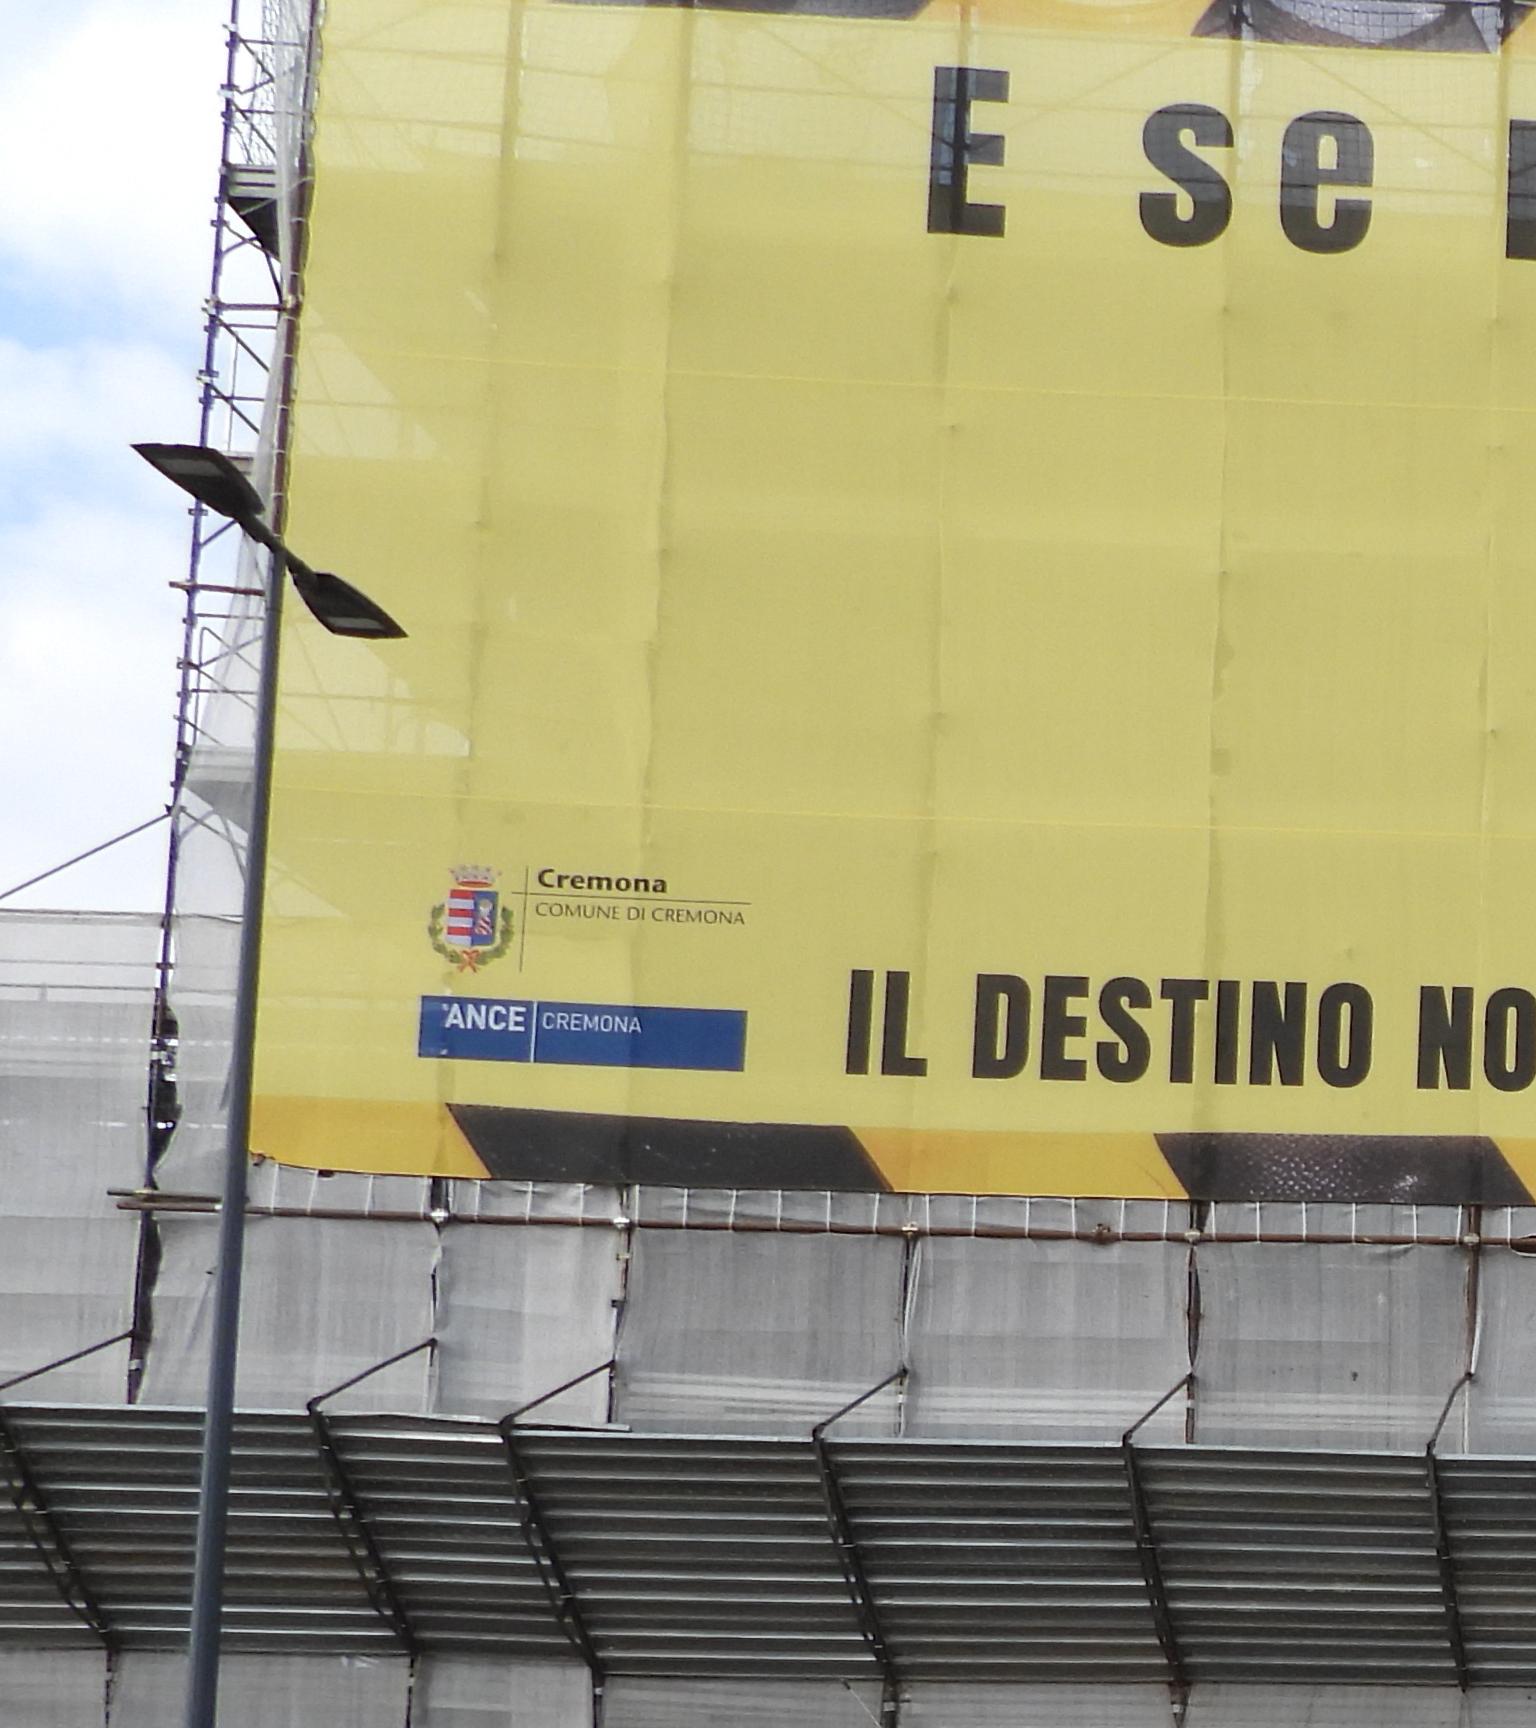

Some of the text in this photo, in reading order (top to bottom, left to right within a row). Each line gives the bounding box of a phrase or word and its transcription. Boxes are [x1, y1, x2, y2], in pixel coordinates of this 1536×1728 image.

[927, 66, 1010, 238] E
[1138, 102, 1375, 255] se
[537, 869, 667, 893] Cremona
[535, 902, 745, 926] COMUNE DI CREMONA
[542, 1012, 642, 1034] CREMONA
[845, 969, 928, 1077] IL
[972, 973, 1374, 1088] DESTINO
